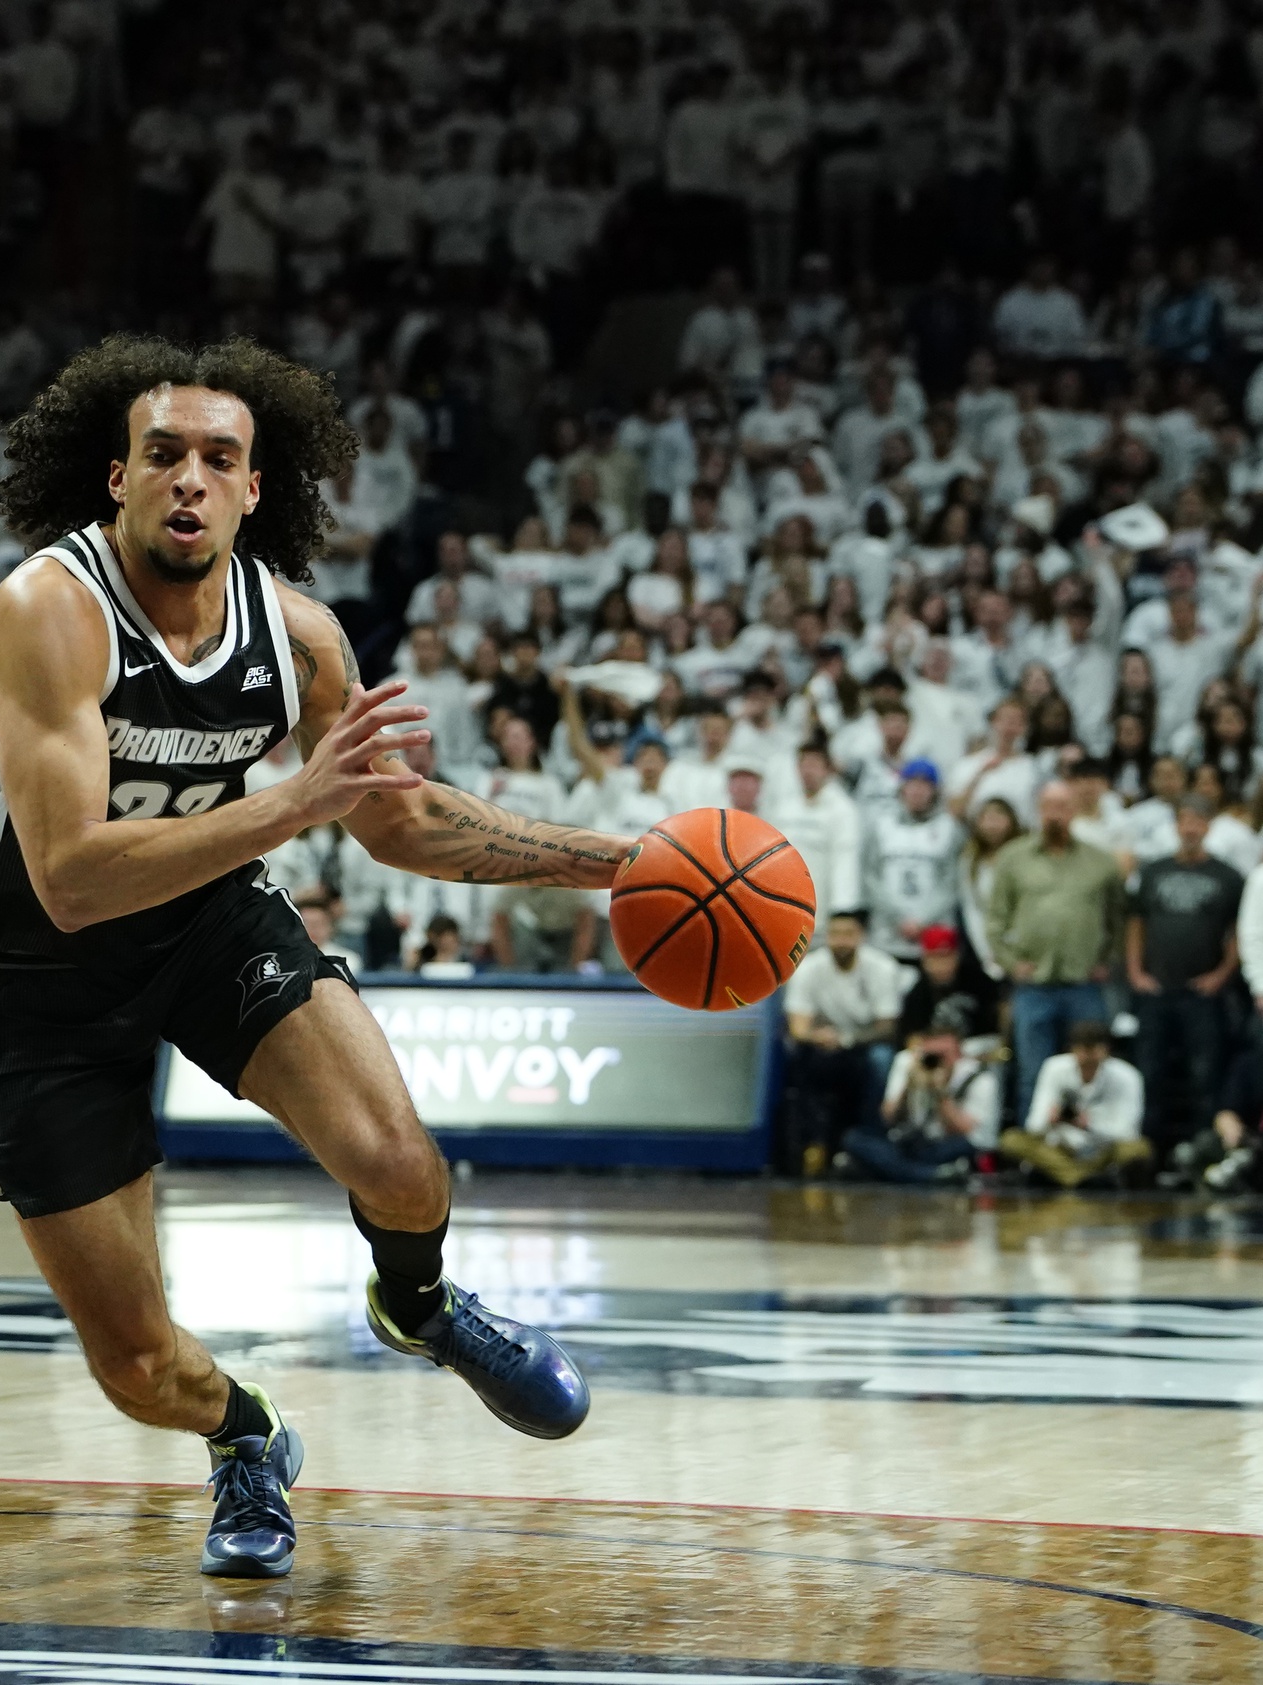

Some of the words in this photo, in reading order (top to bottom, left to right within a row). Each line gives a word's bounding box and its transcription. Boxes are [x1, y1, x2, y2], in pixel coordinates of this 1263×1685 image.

[243, 673, 273, 687] EAST
[245, 665, 266, 678] BIG
[107, 715, 274, 766] PROVIDENCE
[456, 815, 482, 830] God
[541, 841, 559, 851] can
